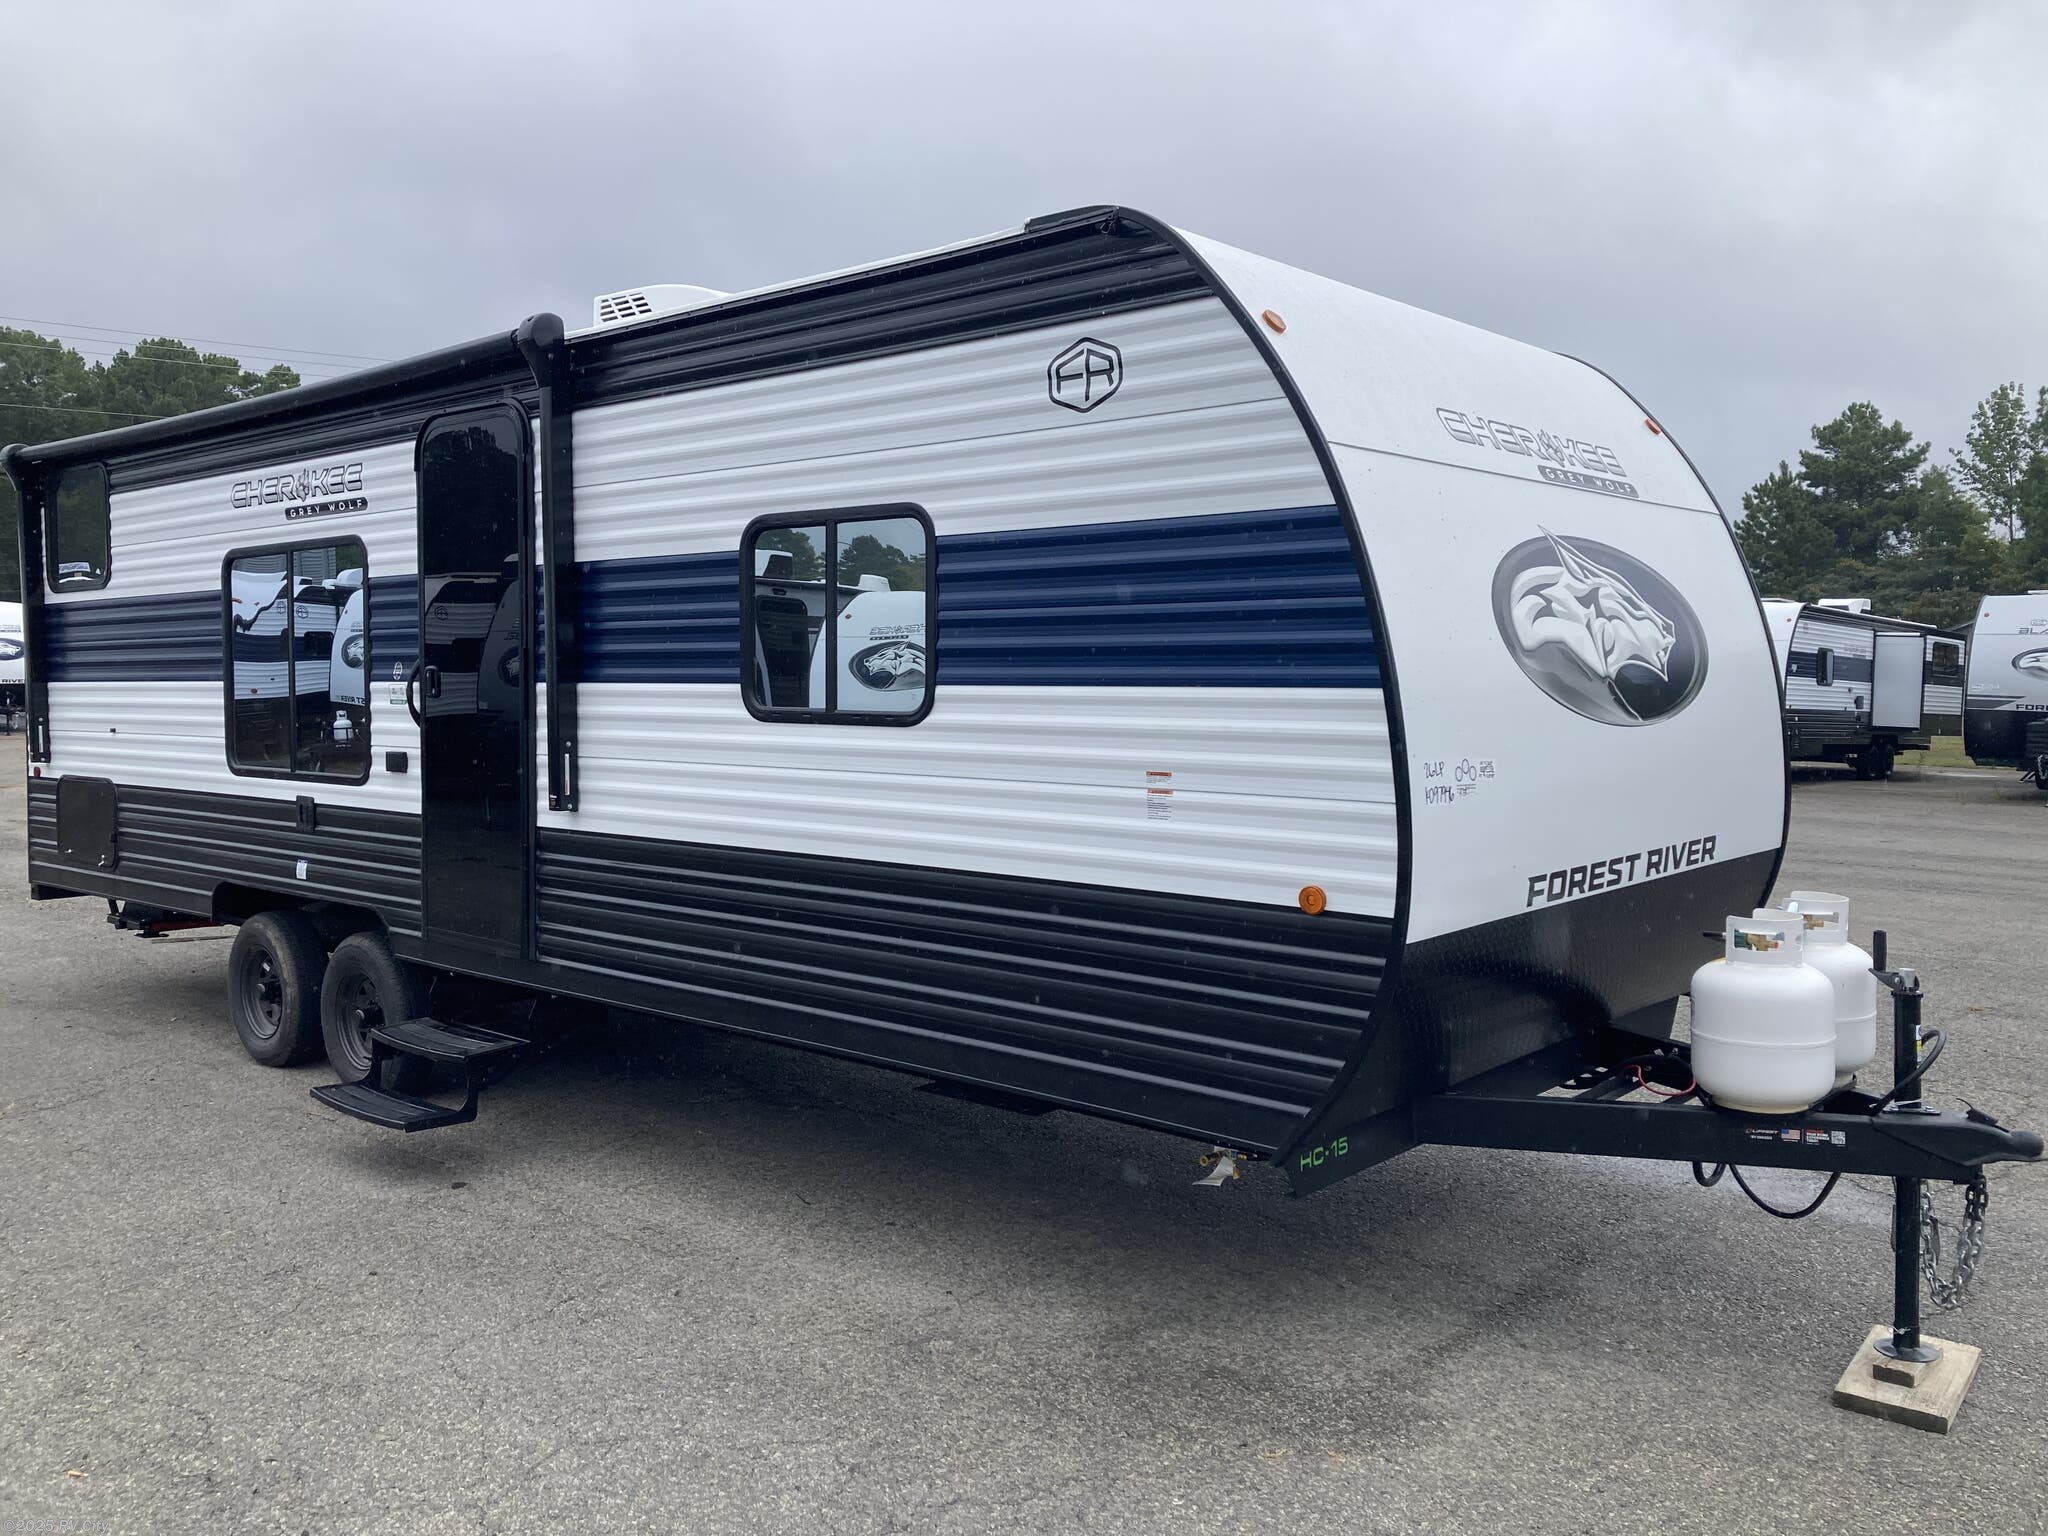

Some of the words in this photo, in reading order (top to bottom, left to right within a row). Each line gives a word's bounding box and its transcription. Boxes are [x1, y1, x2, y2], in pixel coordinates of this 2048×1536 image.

[1545, 468, 1586, 485] GREY
[1594, 477, 1633, 495] WOLF
[290, 505, 320, 518] GREY
[327, 499, 363, 512] WOLF
[2015, 703, 2048, 711] FOR
[1526, 852, 1641, 908] FOREST
[1645, 835, 1717, 877] RIVER
